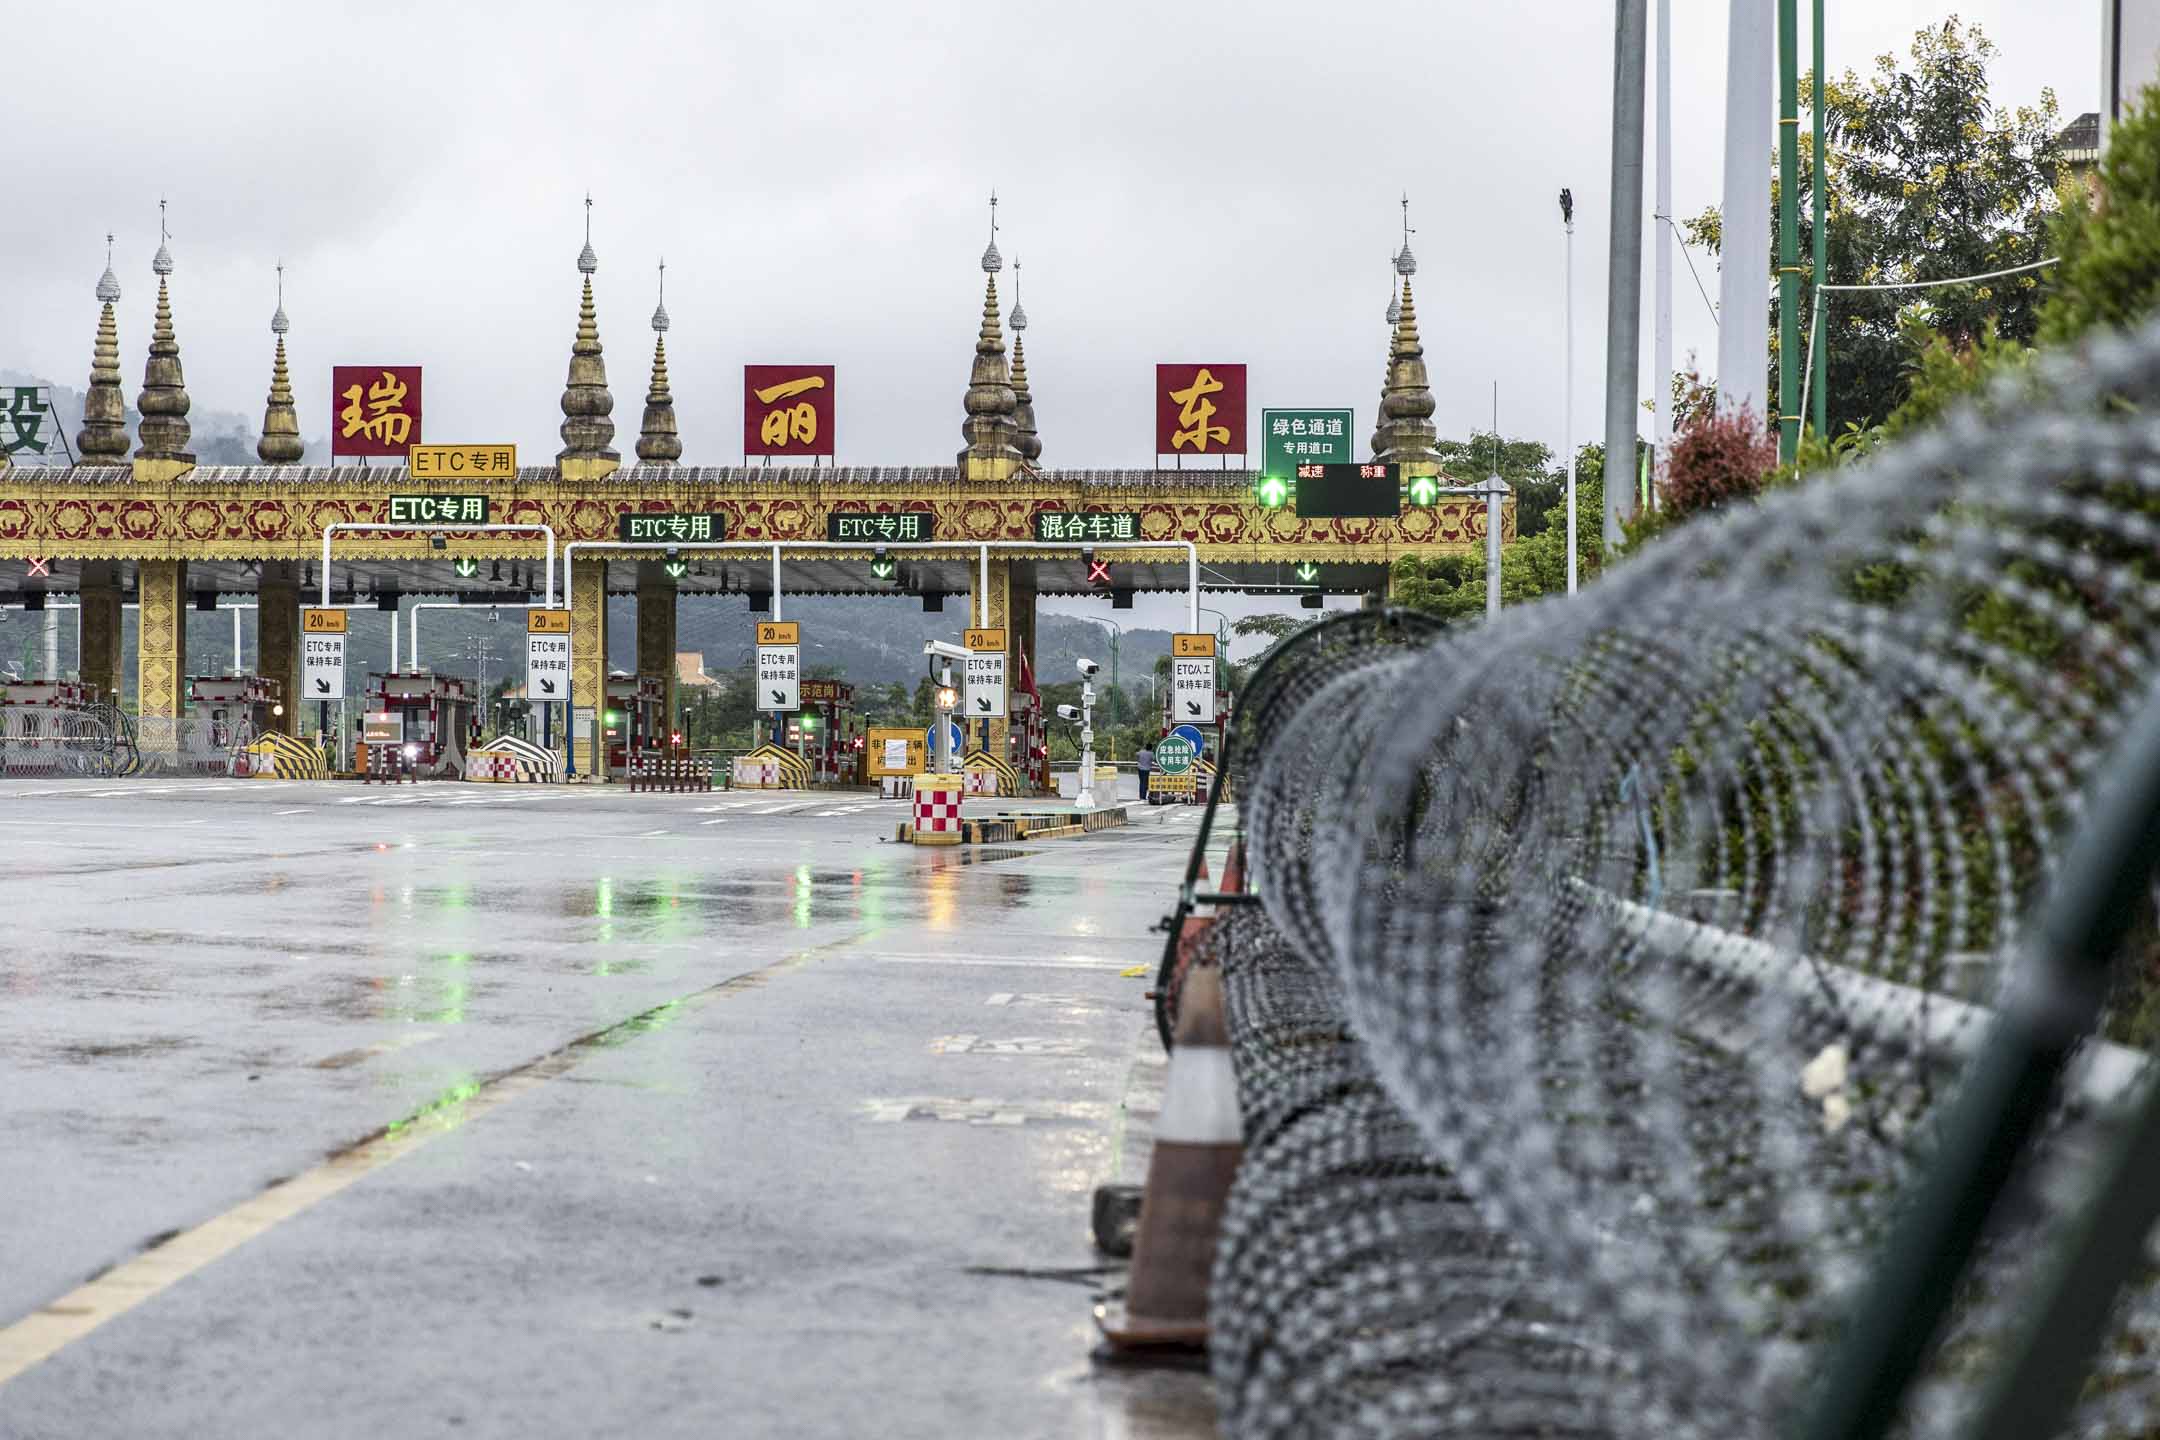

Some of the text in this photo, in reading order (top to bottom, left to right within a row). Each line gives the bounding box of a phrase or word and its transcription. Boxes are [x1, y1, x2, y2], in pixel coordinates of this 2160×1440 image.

[340, 371, 412, 446] 瑞
[754, 375, 824, 447] 丽
[1168, 368, 1230, 453] 东
[1273, 418, 1344, 436] 绿色通道
[1283, 441, 1333, 455] 专用道口
[416, 452, 510, 471] ETC专用
[1298, 465, 1387, 479] 减速 称重
[391, 496, 483, 520] ETC专用
[630, 514, 711, 539] ETC专用
[838, 514, 919, 538] ETC专用
[1041, 513, 1134, 539] 混合车道
[310, 615, 323, 627] 20
[535, 615, 546, 628] 20
[763, 628, 775, 640] 20
[306, 641, 341, 652] ETC专用
[531, 641, 566, 652] ETC专用
[970, 635, 983, 646] 20
[1182, 640, 1188, 651] 5
[306, 656, 342, 666] 保持车距
[531, 660, 566, 670] 保持车距
[761, 654, 795, 665] ETC专用
[967, 659, 1002, 670] ETC专用
[1177, 664, 1211, 675] ETC/人工
[761, 671, 796, 681] 保持车距
[967, 675, 1003, 685] 保持车距
[1177, 679, 1212, 690] 保持车距
